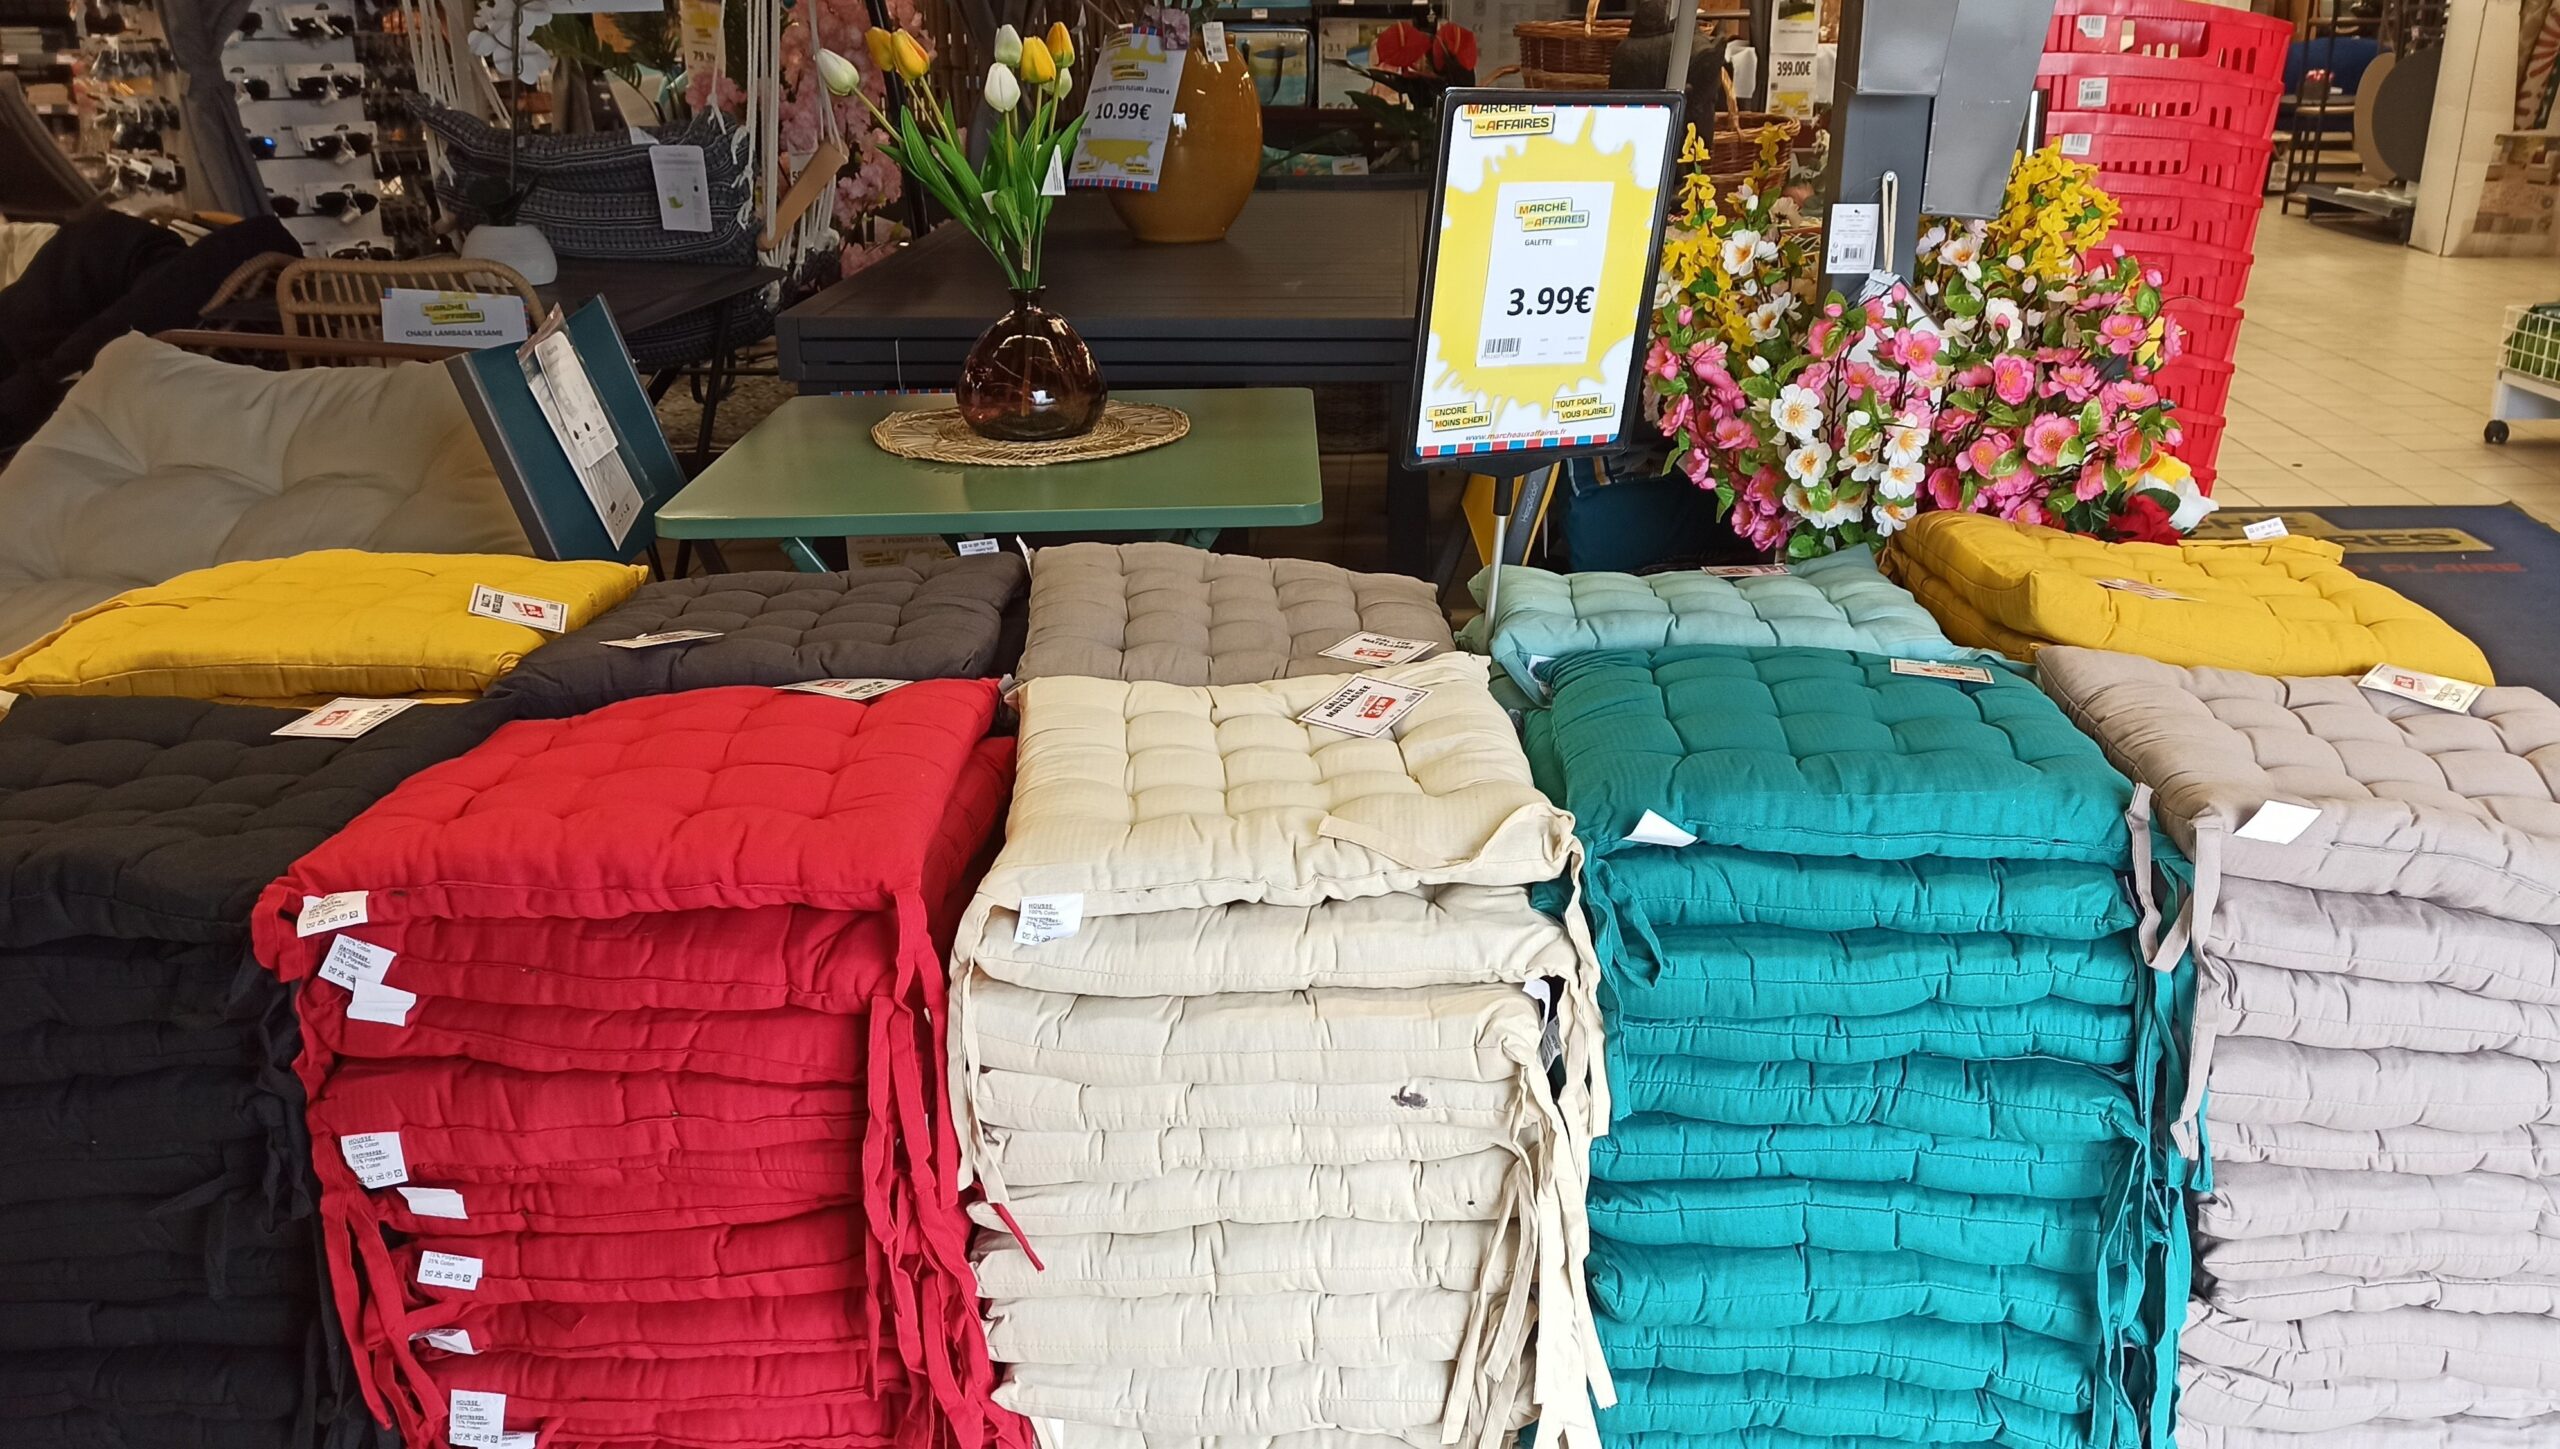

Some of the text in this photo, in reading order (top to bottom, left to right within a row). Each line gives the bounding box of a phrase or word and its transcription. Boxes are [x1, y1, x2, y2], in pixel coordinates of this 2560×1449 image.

[1777, 61, 1811, 76] 399.00€
[1095, 103, 1151, 120] 10.99€
[1486, 118, 1550, 131] AFFAIRES
[1520, 200, 1567, 215] MARCHÉ
[1534, 214, 1585, 227] AFFAIRES
[1506, 287, 1595, 316] 3.99€
[1556, 397, 1597, 408] TOUT POUR
[1434, 406, 1467, 416] ENCORE
[1562, 410, 1580, 419] VOUS
[1583, 406, 1608, 416] PLAIRE
[1435, 419, 1460, 428] MOINS
[1462, 416, 1483, 424] CHER
[1466, 429, 1566, 441] www.marcheauxaffaires.fr
[1324, 688, 1355, 710] GALETTE
[1326, 685, 1371, 718] MATELASSEE
